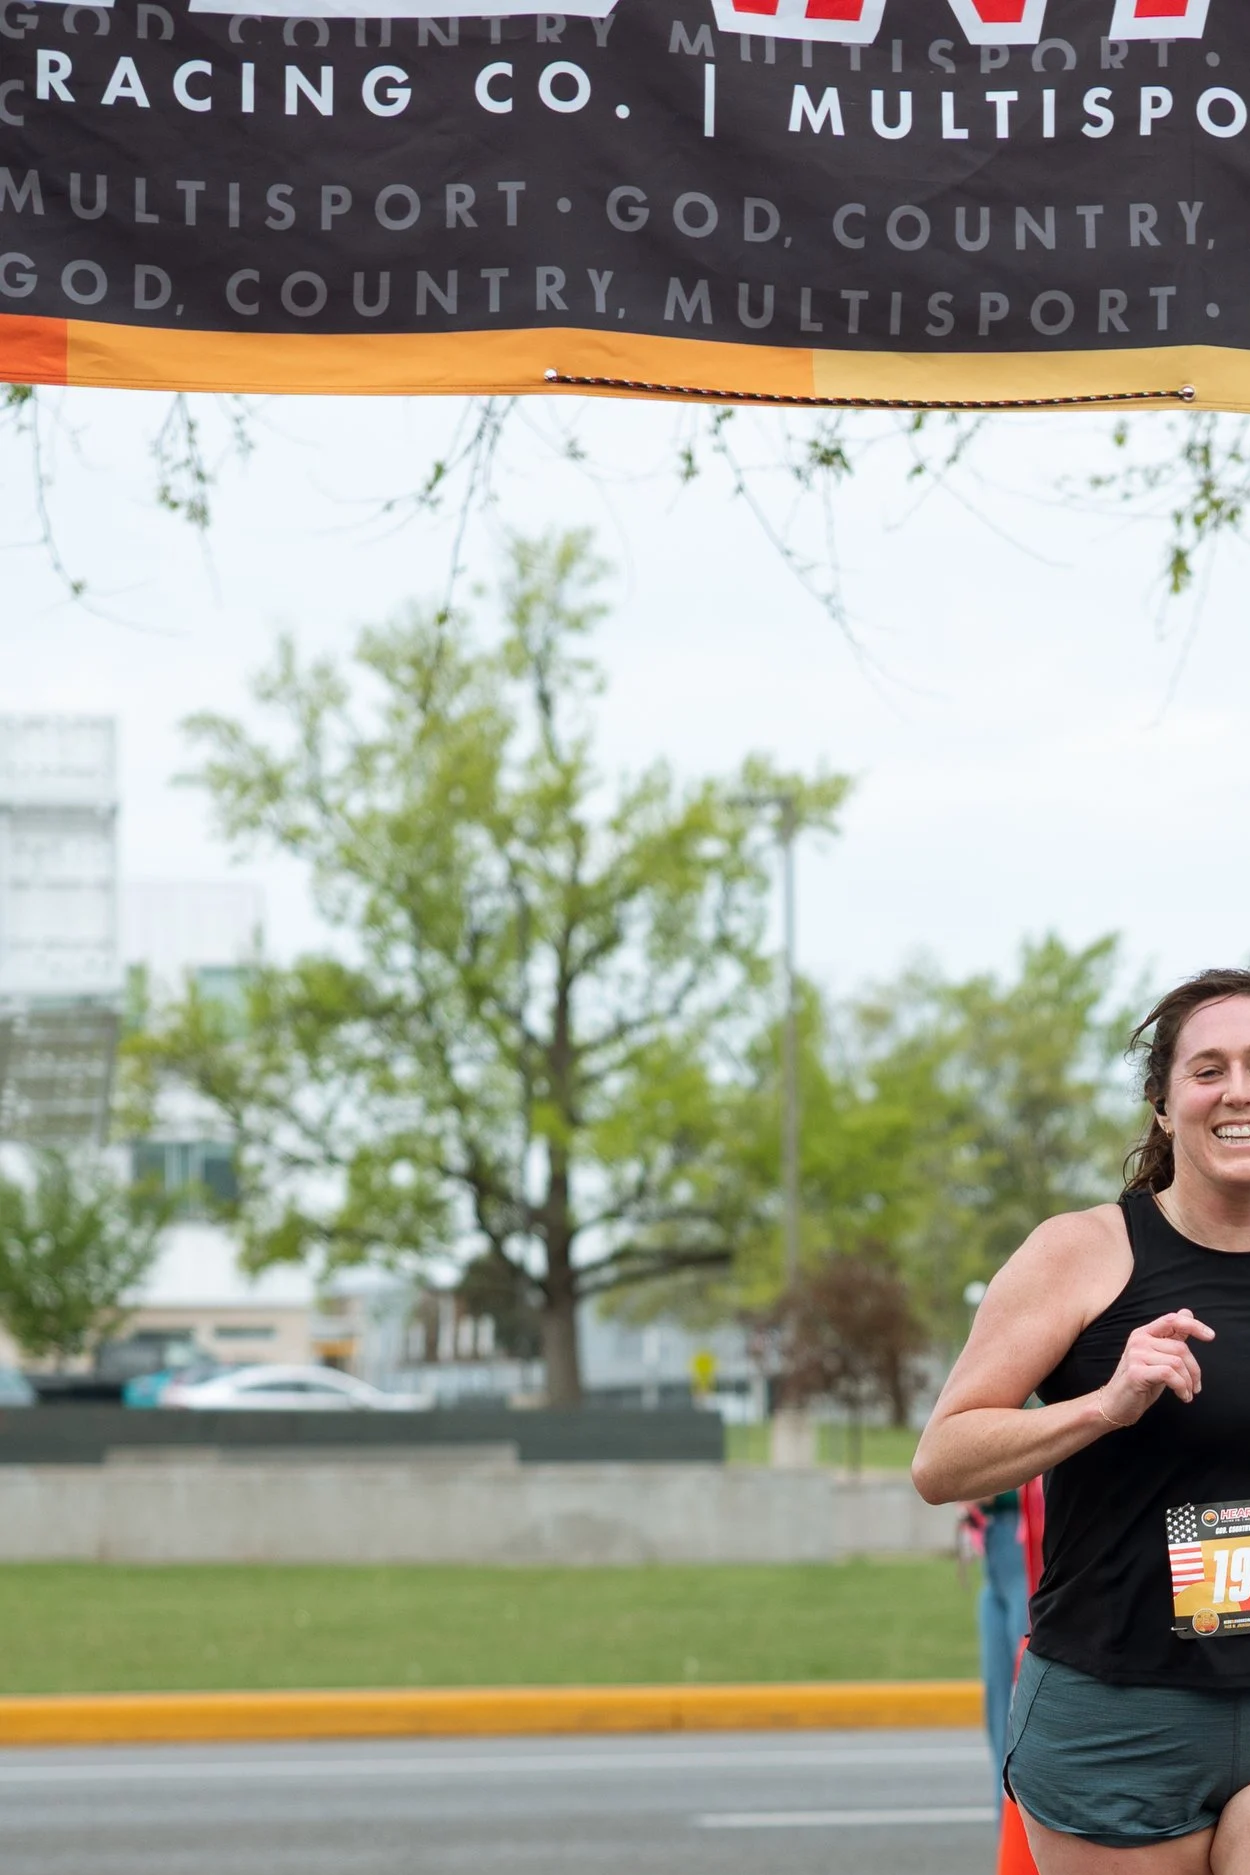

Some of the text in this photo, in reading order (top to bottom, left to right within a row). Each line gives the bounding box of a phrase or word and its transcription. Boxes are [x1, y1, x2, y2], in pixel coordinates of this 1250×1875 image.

[36, 48, 413, 118] RACING
[474, 61, 631, 121] CO.
[0, 167, 527, 231] MULTISPORT
[606, 186, 793, 250] GOD,
[833, 203, 1215, 252] COUNTRY,
[0, 252, 185, 317] GOD,
[226, 265, 626, 318] COUNTRY,
[664, 277, 1177, 337] MULTISPORT
